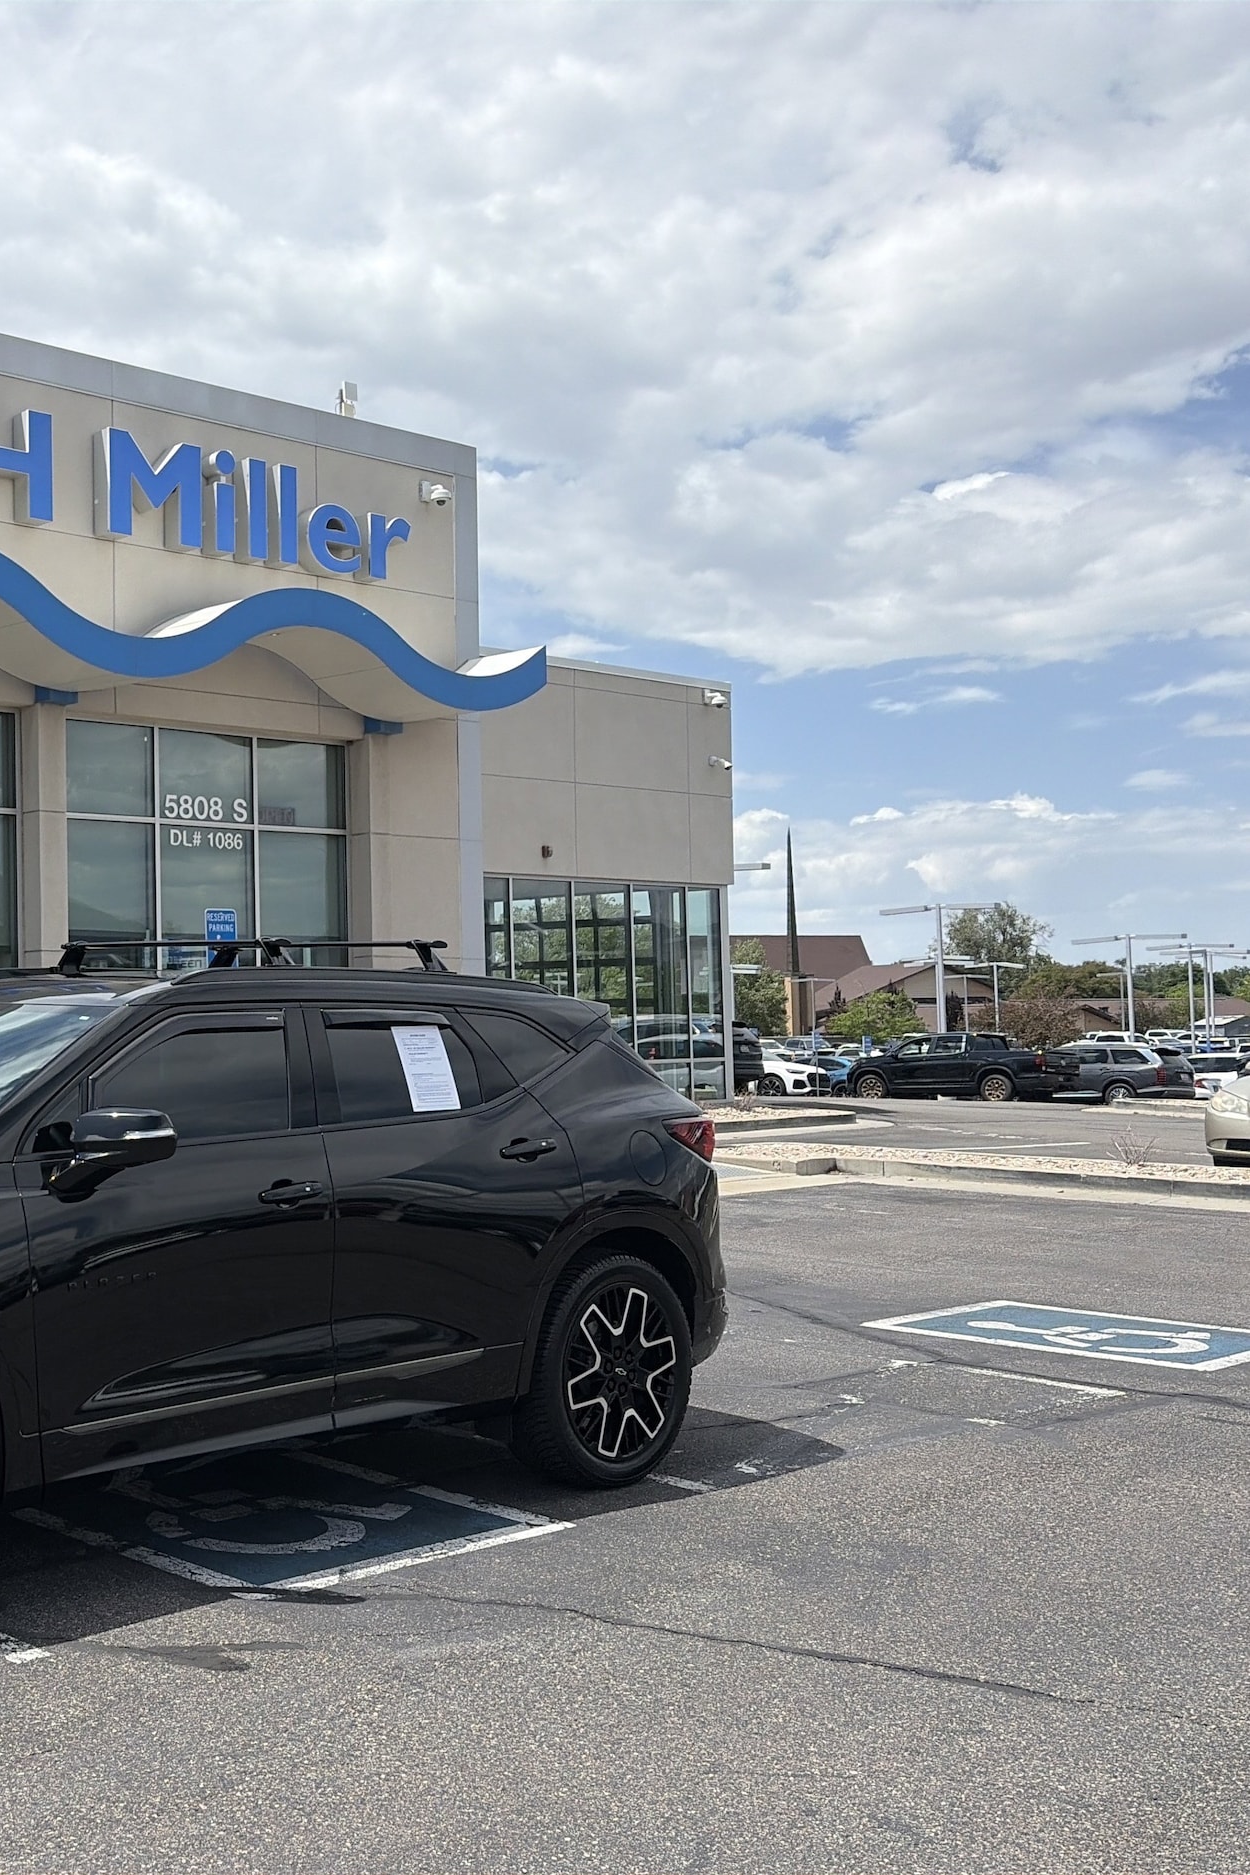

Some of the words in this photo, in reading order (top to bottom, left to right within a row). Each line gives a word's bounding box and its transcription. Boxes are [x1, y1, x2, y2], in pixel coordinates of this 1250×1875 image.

[97, 426, 412, 583] Miller
[164, 794, 223, 820] 5808
[233, 798, 248, 822] S
[170, 829, 202, 847] DL#
[207, 832, 243, 850] 1086
[206, 912, 235, 921] RESERVED
[208, 923, 234, 932] PARKING
